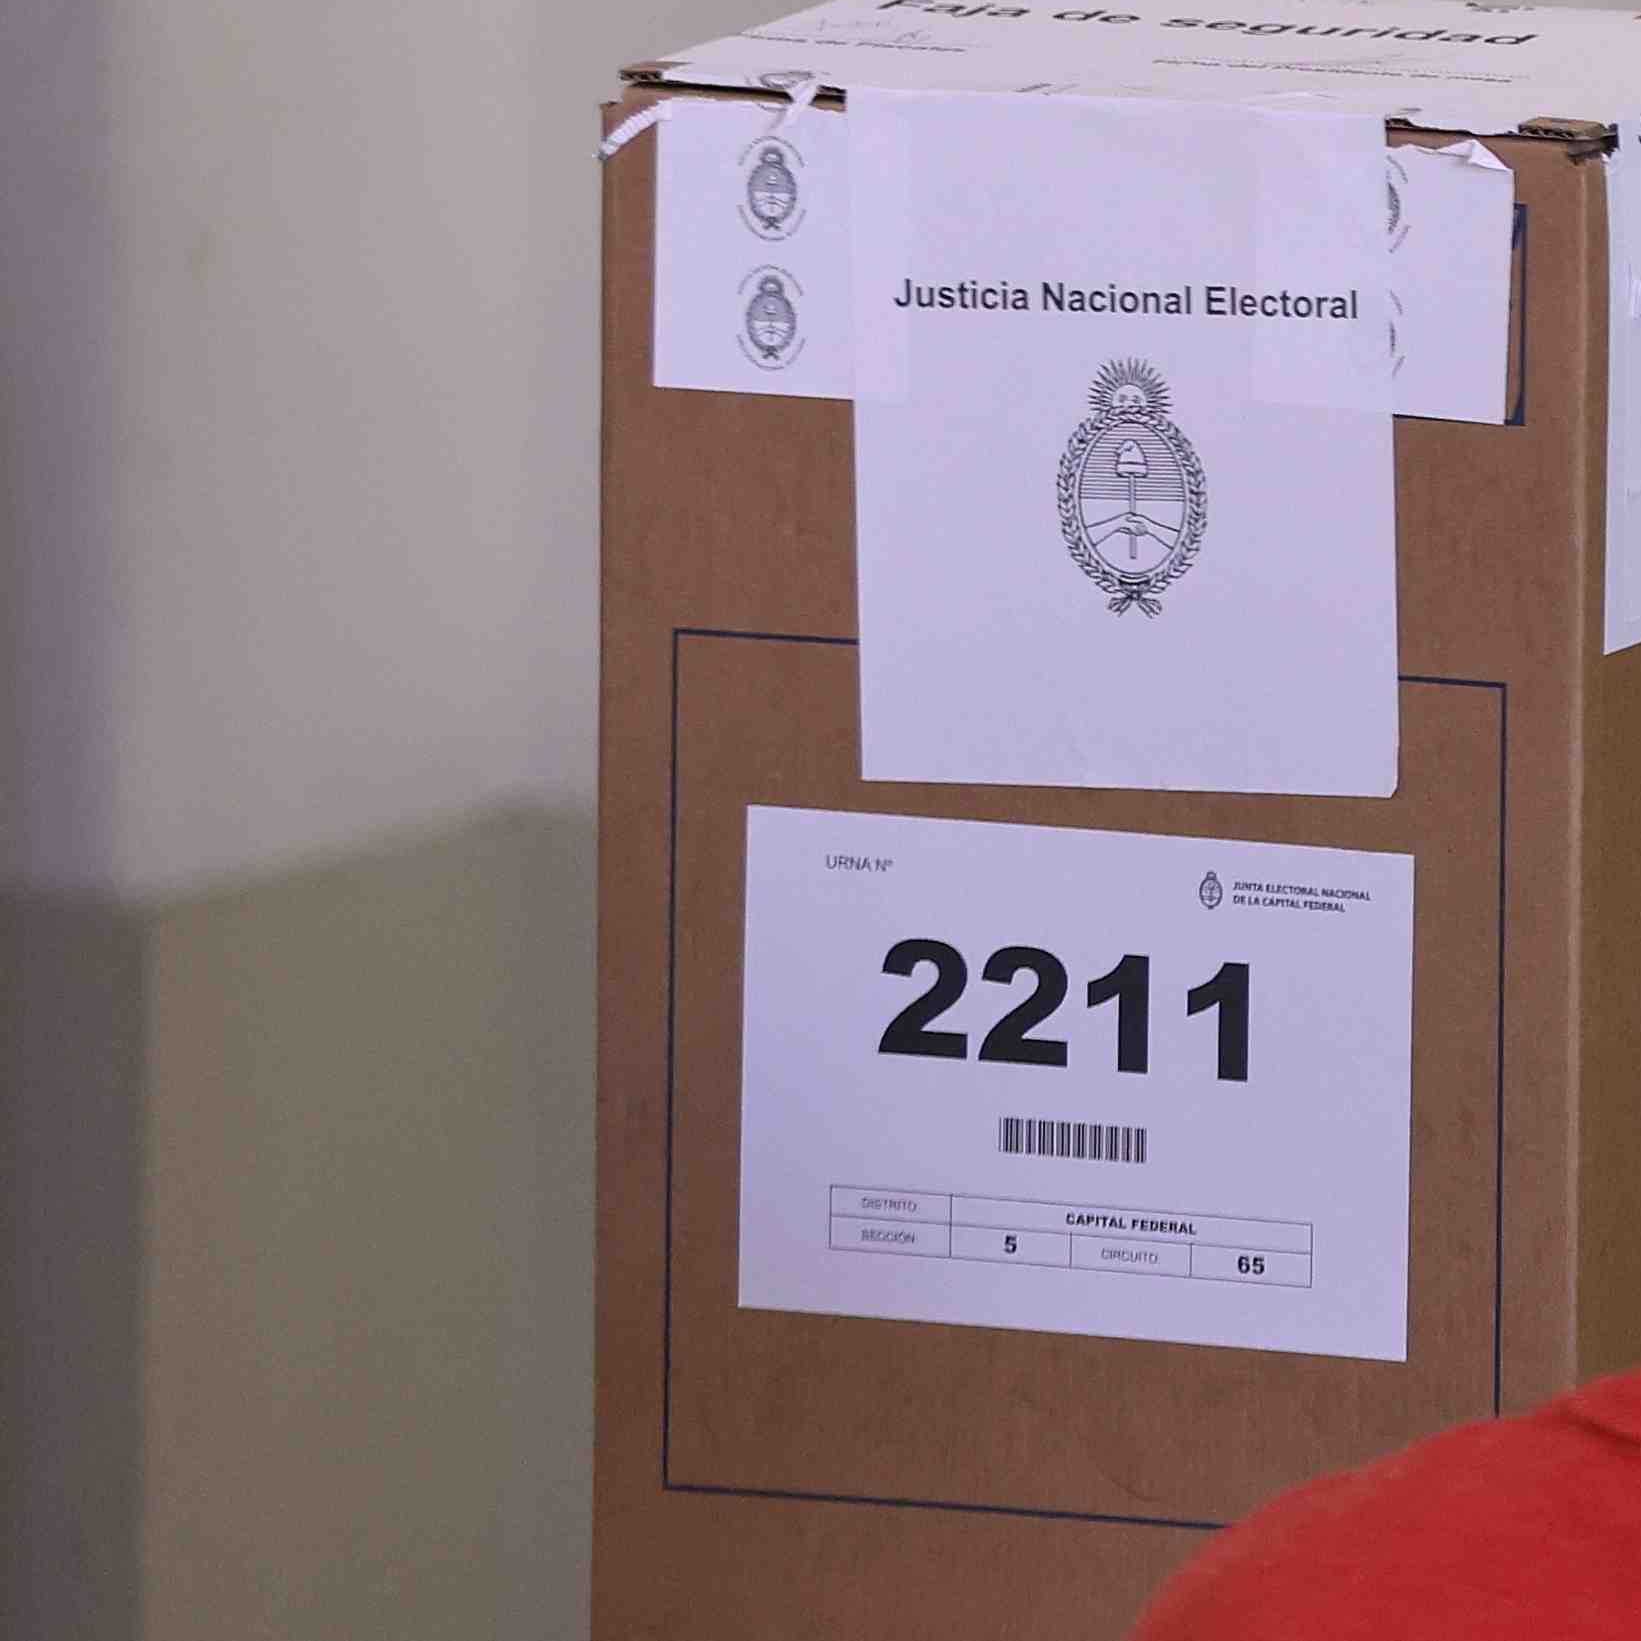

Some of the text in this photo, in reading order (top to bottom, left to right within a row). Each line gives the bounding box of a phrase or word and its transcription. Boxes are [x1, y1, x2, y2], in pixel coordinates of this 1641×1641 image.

[1052, 7, 1140, 24] de
[1160, 15, 1537, 46] seguridad
[894, 278, 1359, 320] Justicia Nacional Electoral
[826, 855, 872, 872] URNA
[1233, 882, 1371, 901] JUNTA ELECTORAL NACIONAL
[1233, 895, 1346, 912] DE LA CAPITAL FEDERAL
[878, 939, 1250, 1082] 2211
[861, 1197, 917, 1213] DISTRITO
[1066, 1213, 1197, 1235] CAPITAL FEDERAL
[1004, 1234, 1017, 1254] 5
[1102, 1247, 1158, 1264] CIRCUITO
[1237, 1256, 1265, 1274] 65
